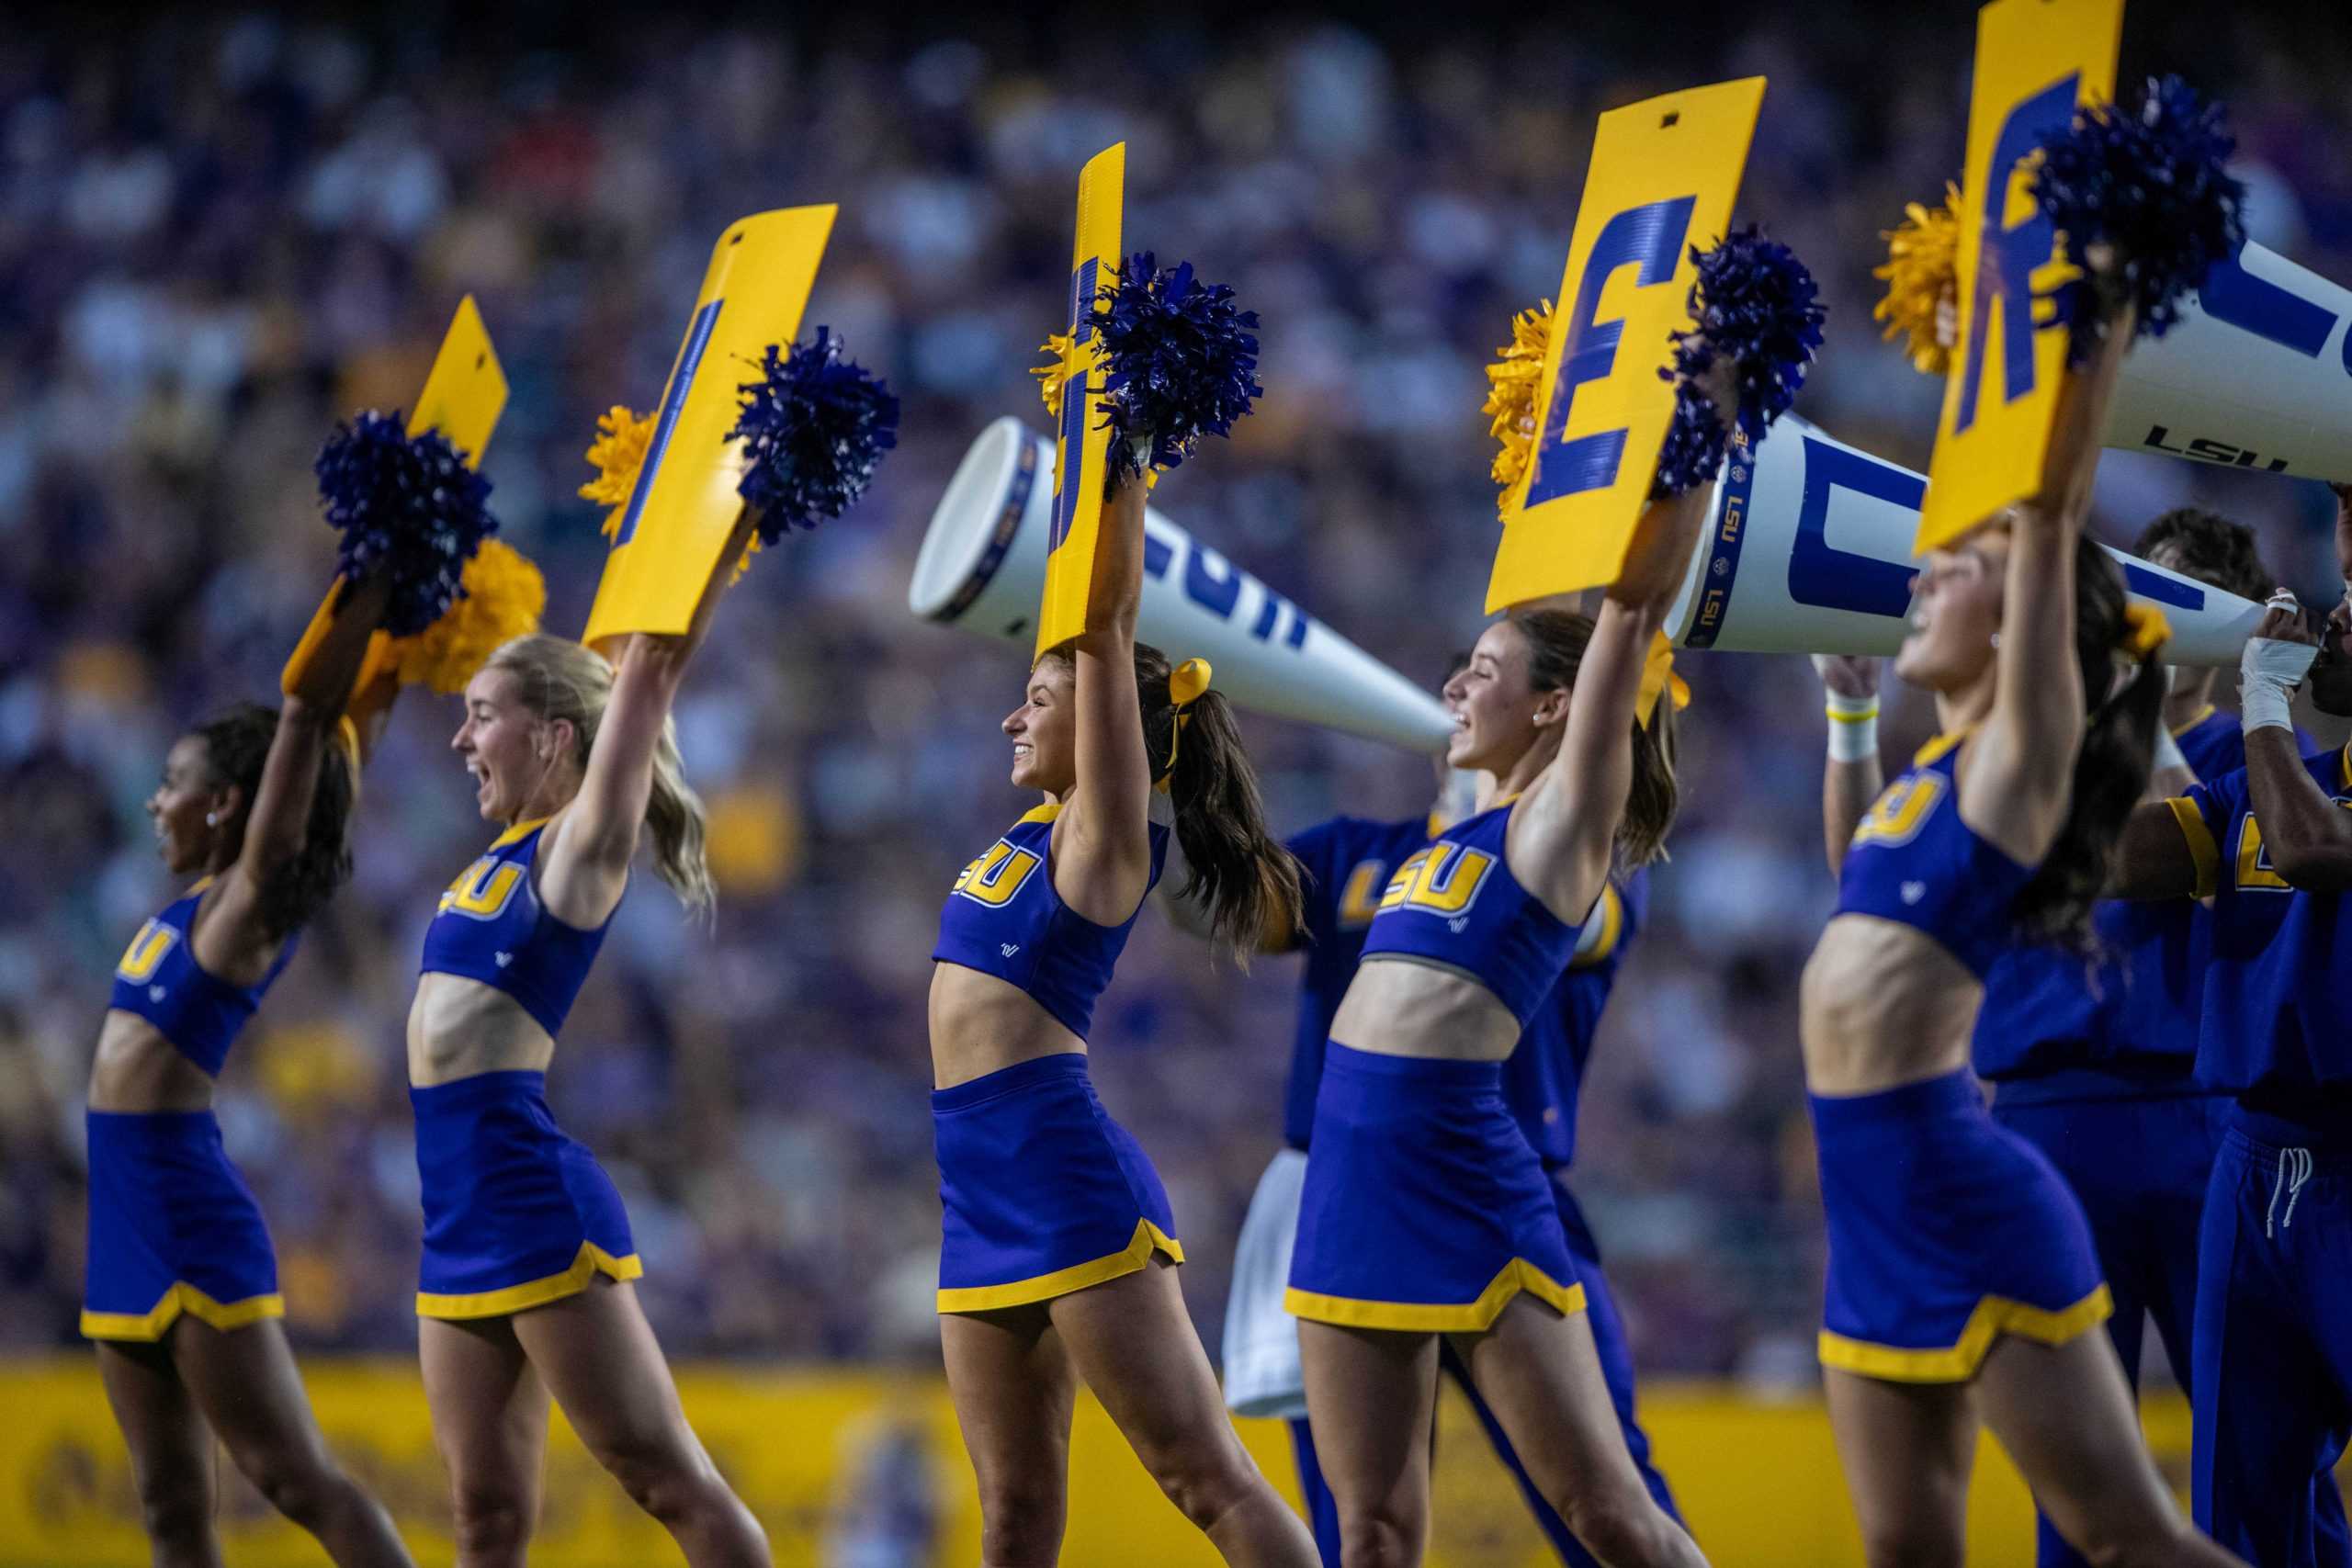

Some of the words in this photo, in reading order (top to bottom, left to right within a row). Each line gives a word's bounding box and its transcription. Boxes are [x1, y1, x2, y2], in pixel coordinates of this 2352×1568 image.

[1522, 194, 1697, 509] E
[2144, 423, 2288, 472] LSU
[1720, 495, 1744, 544] LSU
[1700, 589, 1724, 626] LSU
